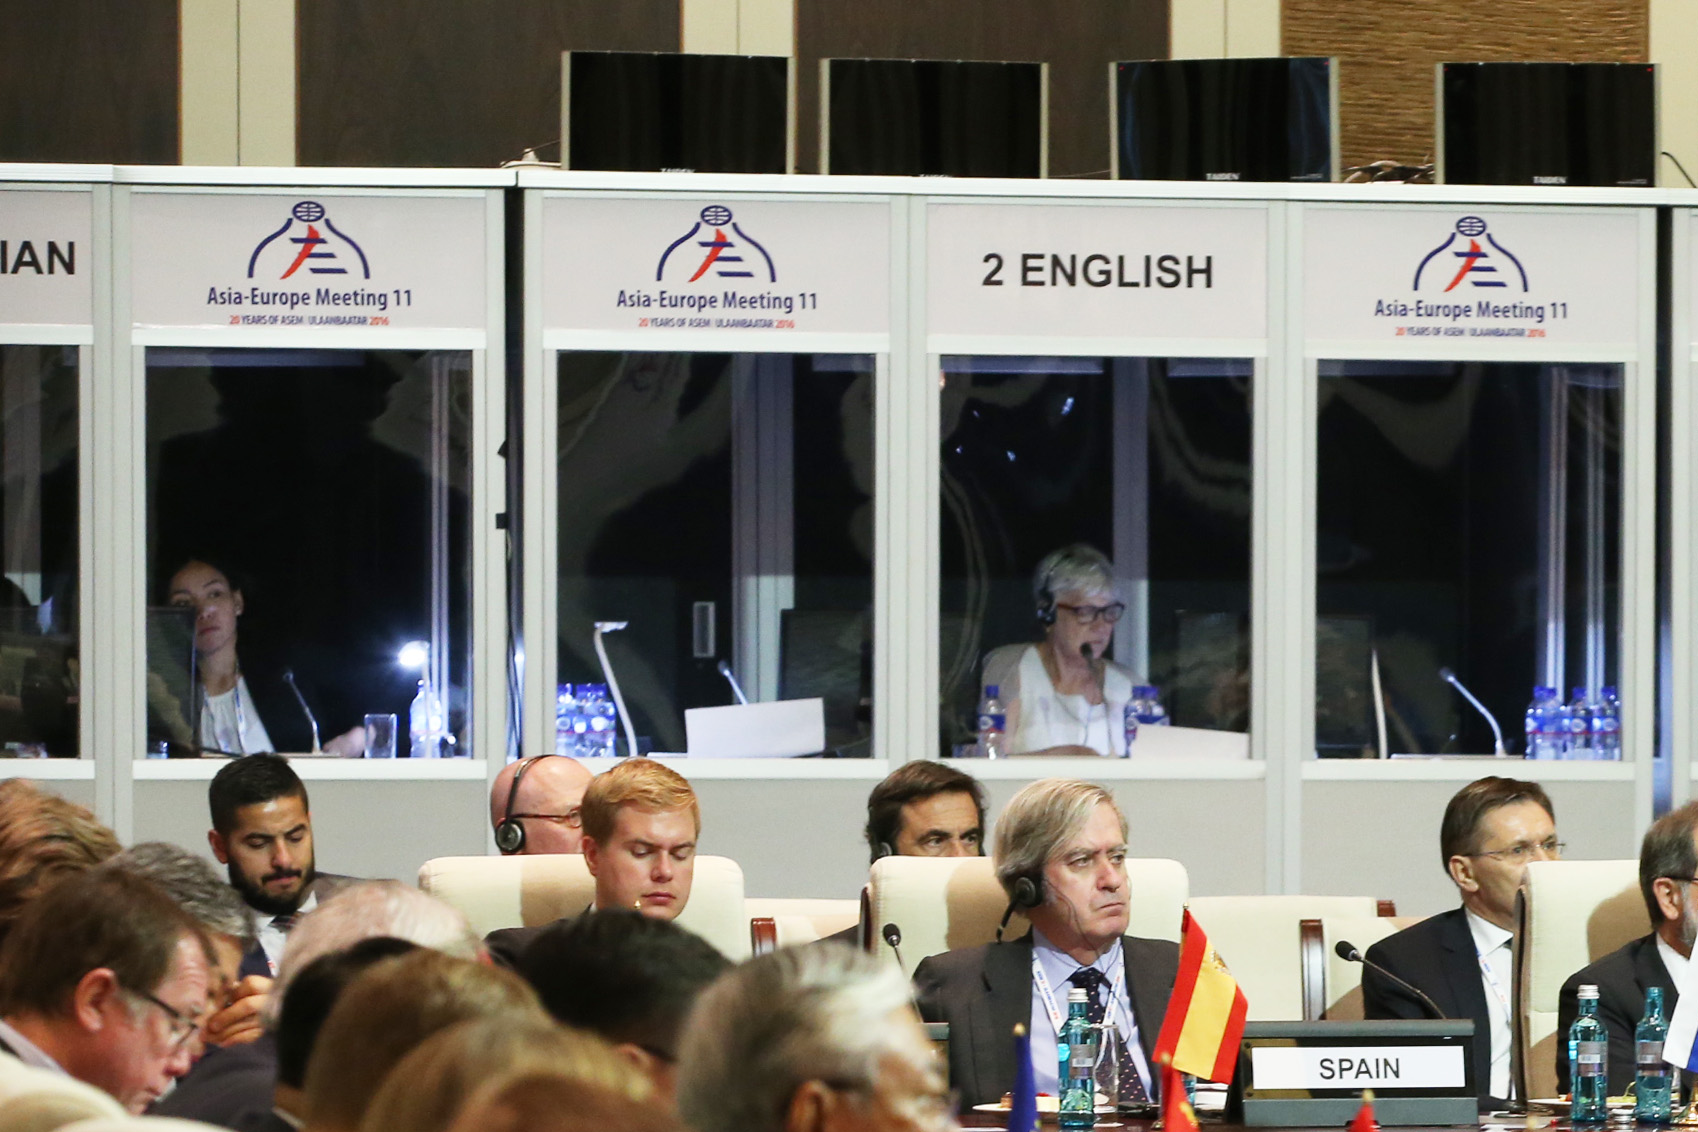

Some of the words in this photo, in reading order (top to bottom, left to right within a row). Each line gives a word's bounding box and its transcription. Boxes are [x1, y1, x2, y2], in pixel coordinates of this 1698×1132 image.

[982, 252, 1004, 287] 2
[1020, 253, 1213, 289] ENGLISH
[206, 286, 311, 312] Asia-Europe
[315, 287, 389, 313] Meeting
[393, 289, 412, 307] 11
[616, 289, 719, 314] Asia-Europe
[722, 290, 794, 315] Meeting
[799, 292, 817, 310] 11
[1374, 299, 1473, 322] Asia-Europe
[1476, 300, 1546, 324] Meeting
[1550, 301, 1568, 319] 11
[1319, 1057, 1401, 1081] SPAIN
